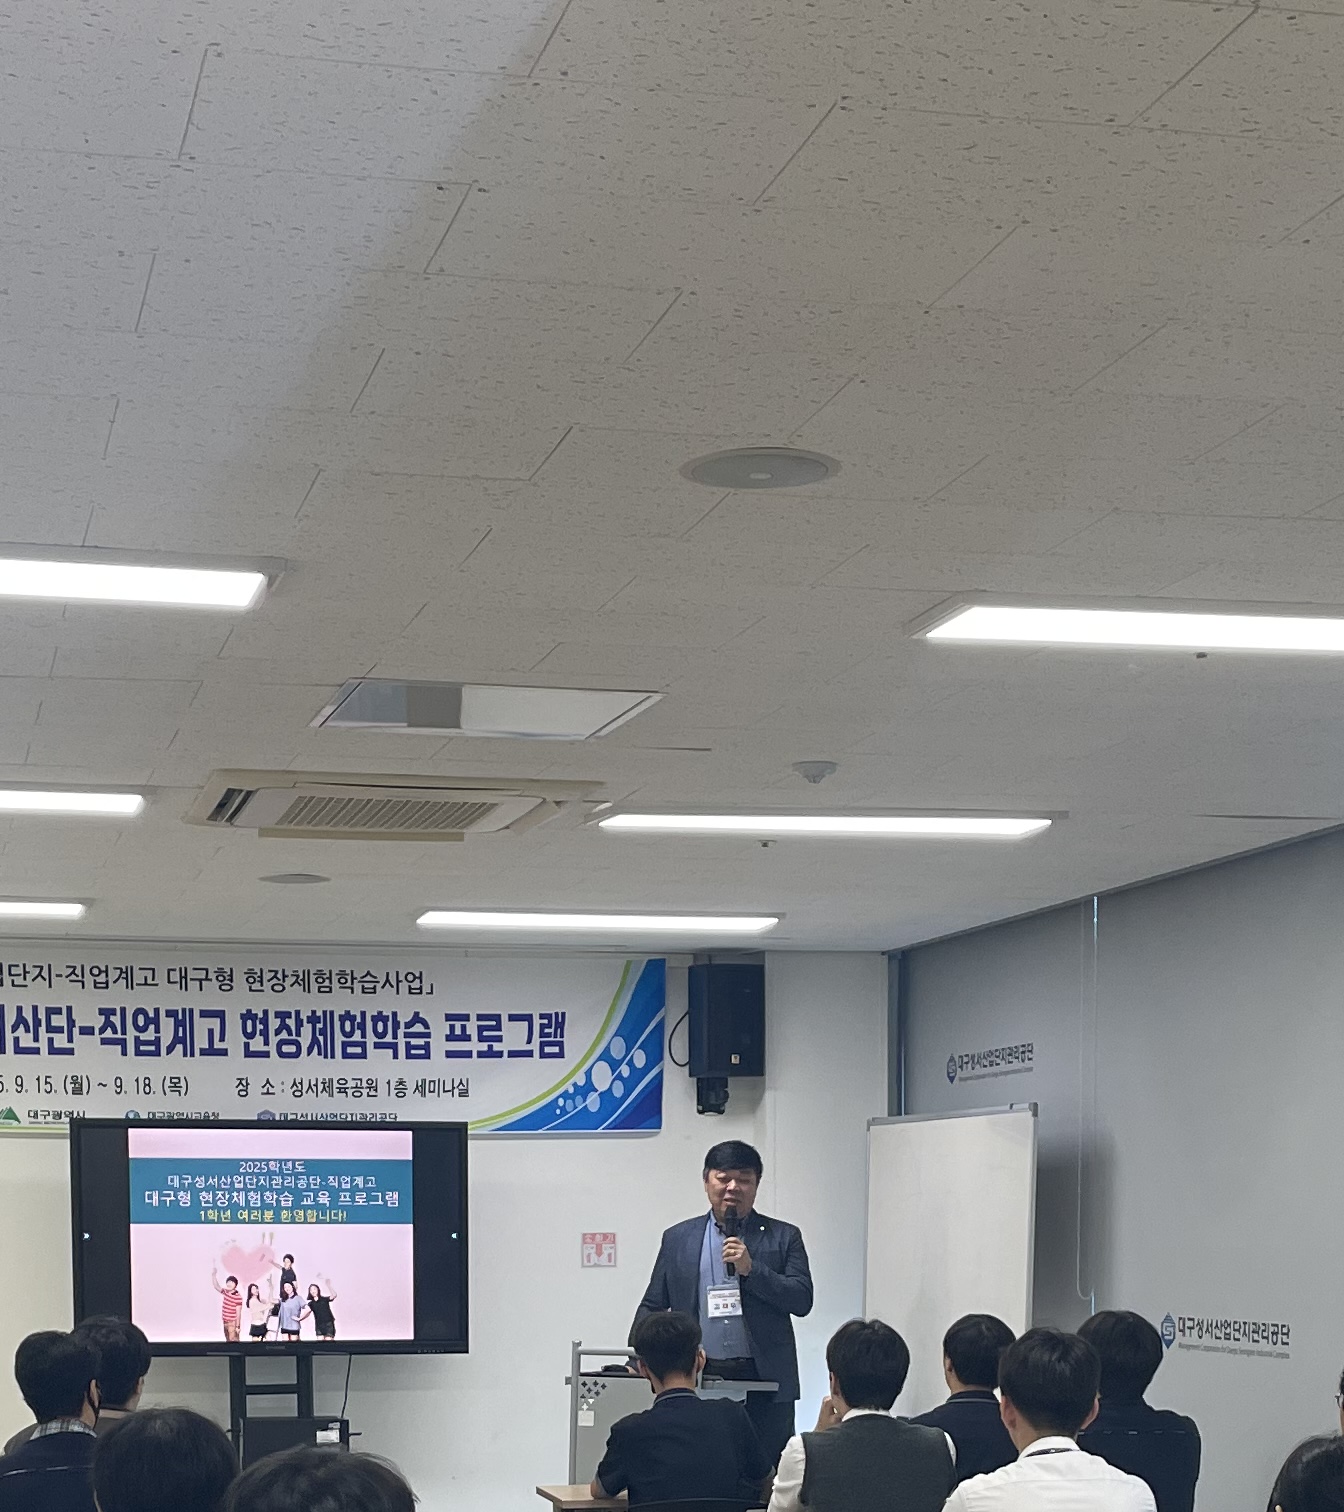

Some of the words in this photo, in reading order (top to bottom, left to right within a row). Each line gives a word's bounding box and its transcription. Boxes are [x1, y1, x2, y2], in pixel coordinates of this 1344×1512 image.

[166, 965, 234, 993] 대구형
[244, 967, 435, 996] 현장체험학습사업」
[240, 1008, 433, 1060] 현장체험학습
[444, 1011, 567, 1060] 프로그램
[63, 1074, 91, 1096] (월)
[161, 1075, 190, 1097] (목)
[290, 1077, 379, 1099] 성서체육공원
[385, 1078, 408, 1099] 1층
[413, 1078, 470, 1099] 세미나실
[239, 1161, 307, 1174] 2025학년도
[144, 1190, 191, 1207] 대구형
[199, 1190, 295, 1207] 현장체험학습
[301, 1191, 331, 1207] 교육
[338, 1191, 399, 1207] 프로그램
[199, 1209, 231, 1222] 1학년
[237, 1209, 275, 1222] 여러분
[1178, 1317, 1290, 1346] 대구성서산업단지관리공단
